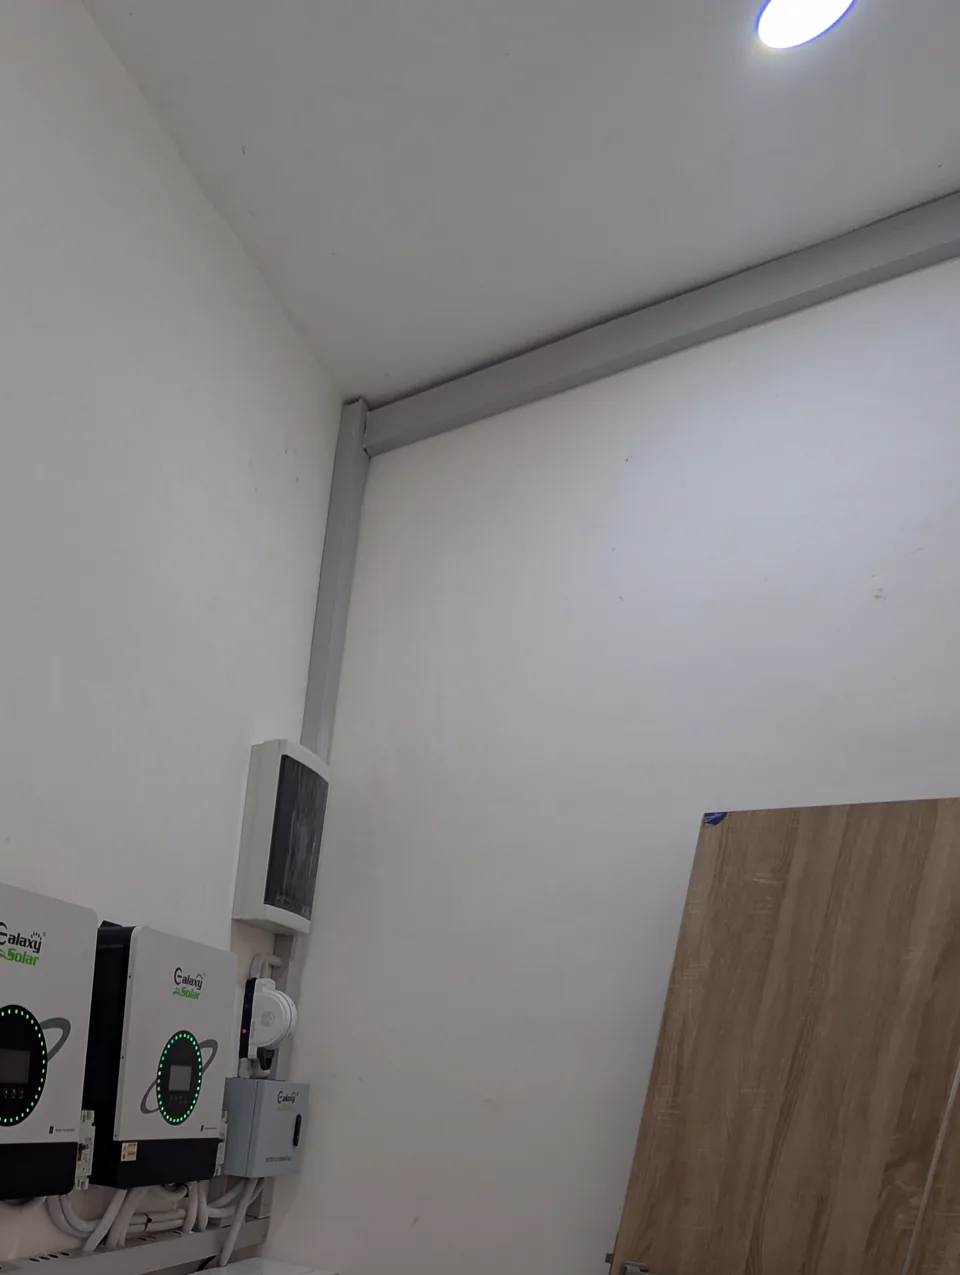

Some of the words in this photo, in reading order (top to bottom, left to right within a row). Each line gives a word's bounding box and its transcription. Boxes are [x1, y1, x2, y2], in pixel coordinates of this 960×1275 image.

[6, 948, 40, 966] Solar
[173, 967, 203, 991] Galaxy
[180, 986, 200, 999] Solar
